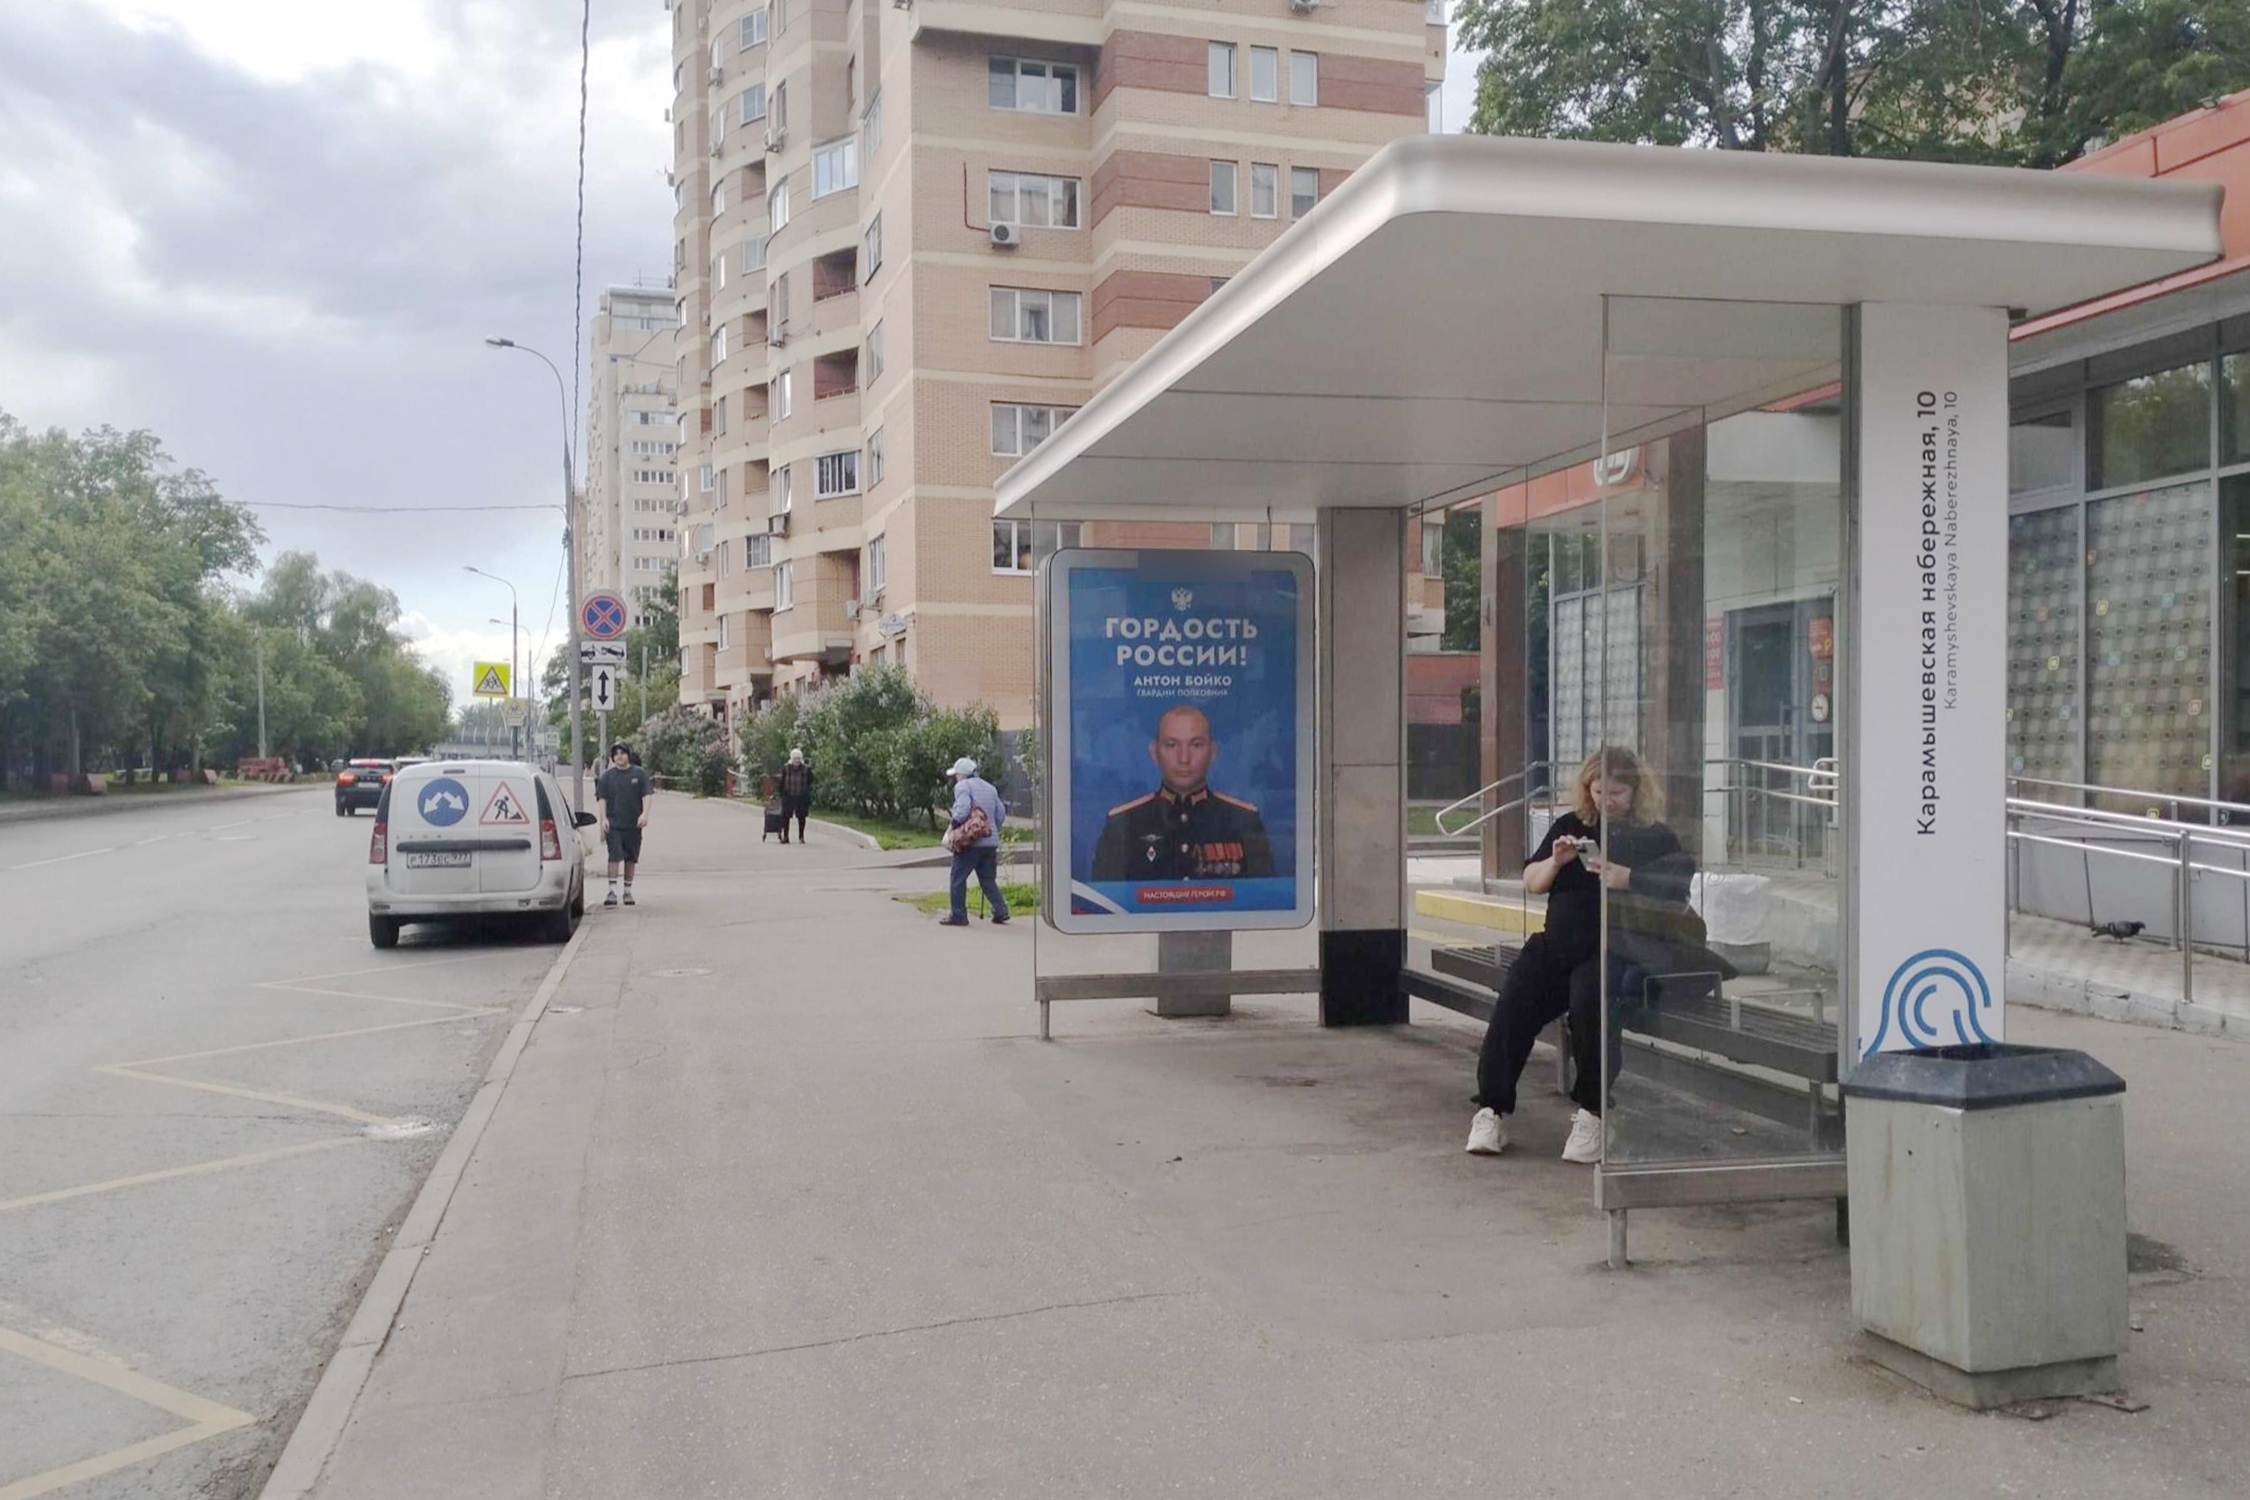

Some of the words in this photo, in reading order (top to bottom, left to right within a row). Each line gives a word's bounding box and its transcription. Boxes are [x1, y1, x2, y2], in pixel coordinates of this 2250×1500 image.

[1917, 391, 1936, 418] 10
[1944, 391, 1957, 408] 10
[1944, 414, 1960, 546] Naberezhnaya,
[1917, 426, 1940, 602] набережная,
[1105, 617, 1258, 641] ГОРДОСТЬ
[1944, 552, 1960, 709] Karamyshevskaya
[1117, 644, 1247, 666] РОССИИ!
[1134, 675, 1180, 686] АНТОН
[1185, 673, 1232, 686] БОЙКО
[1917, 611, 1939, 835] Карамышевская
